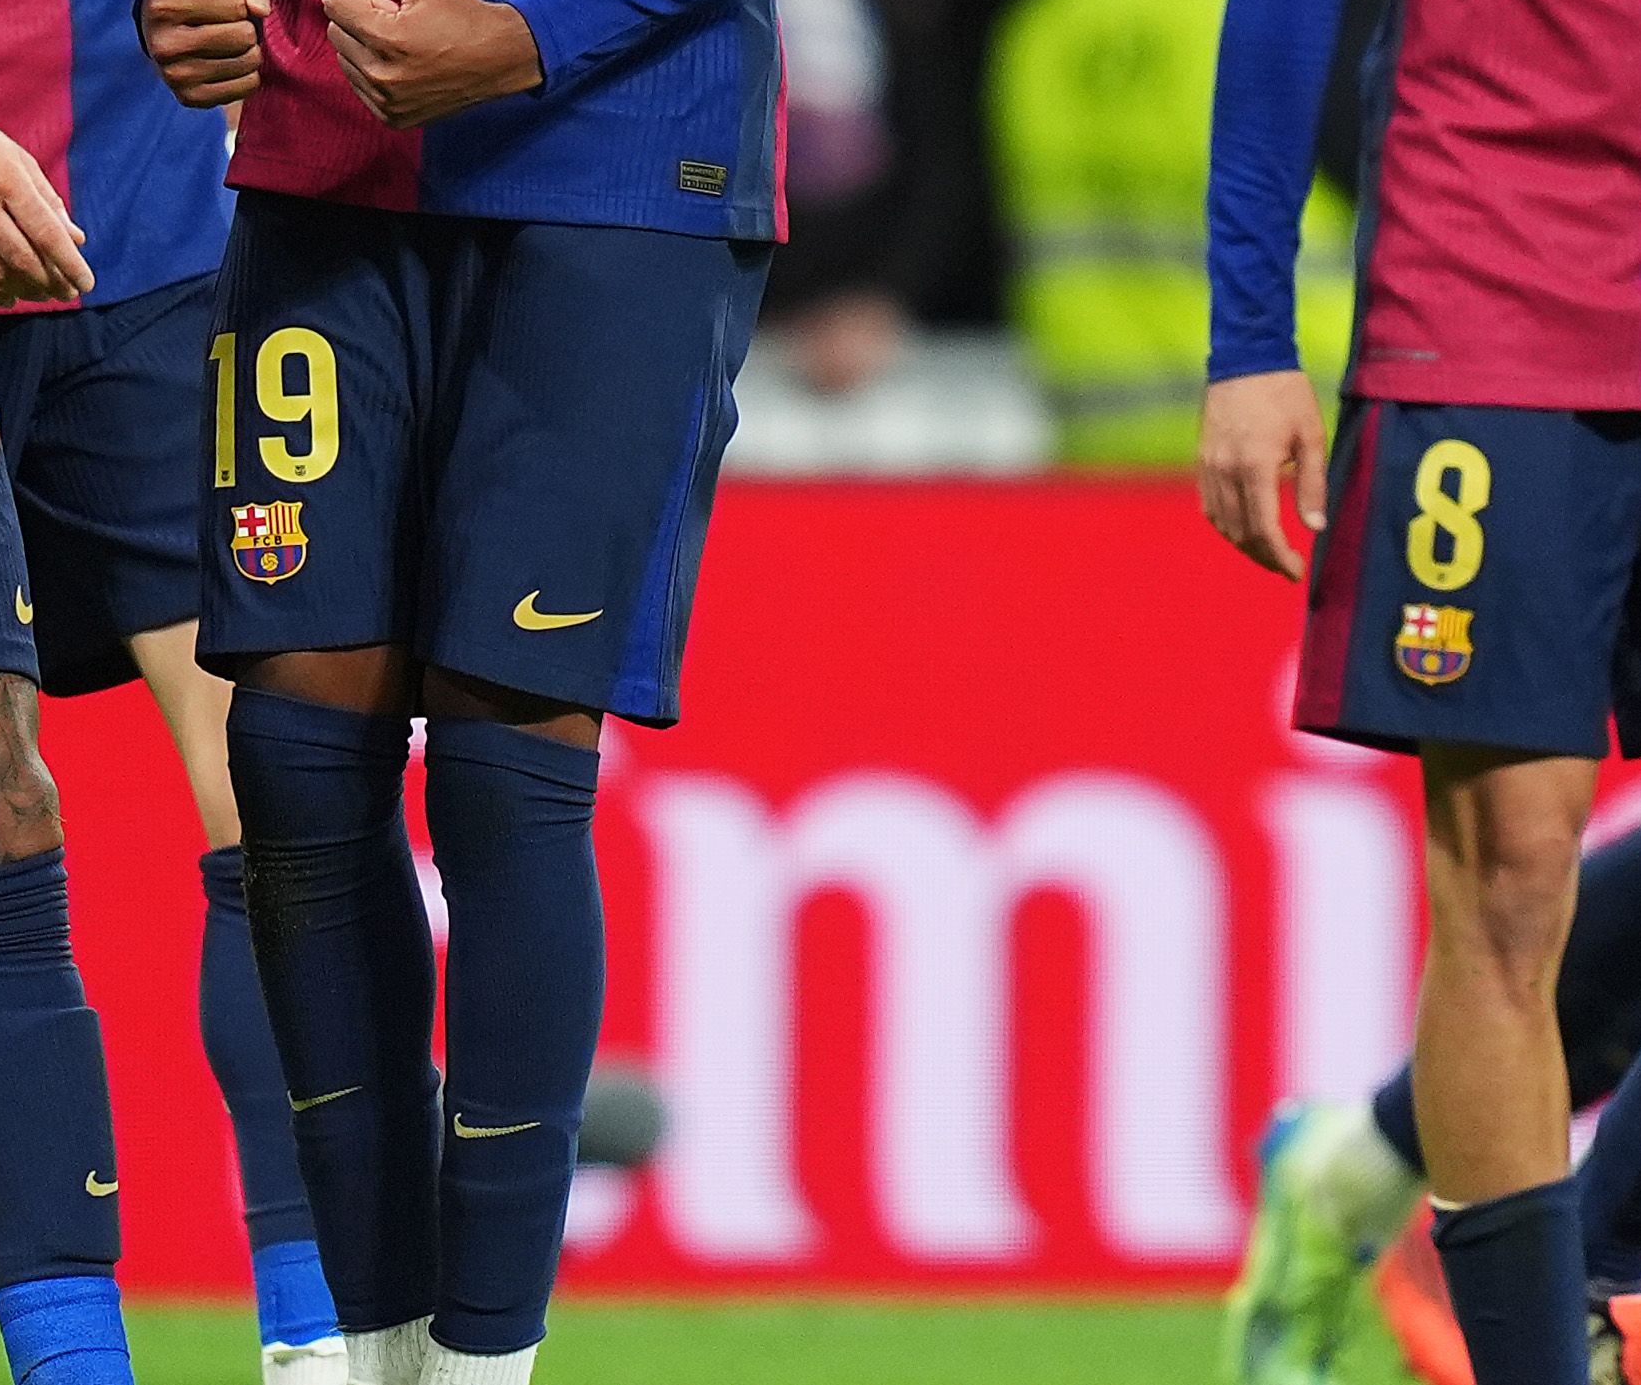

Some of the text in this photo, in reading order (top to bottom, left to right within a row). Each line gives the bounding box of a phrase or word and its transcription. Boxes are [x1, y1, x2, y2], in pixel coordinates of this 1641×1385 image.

[208, 327, 340, 489] 19
[252, 535, 283, 547] FCB
[1407, 439, 1492, 592] 8
